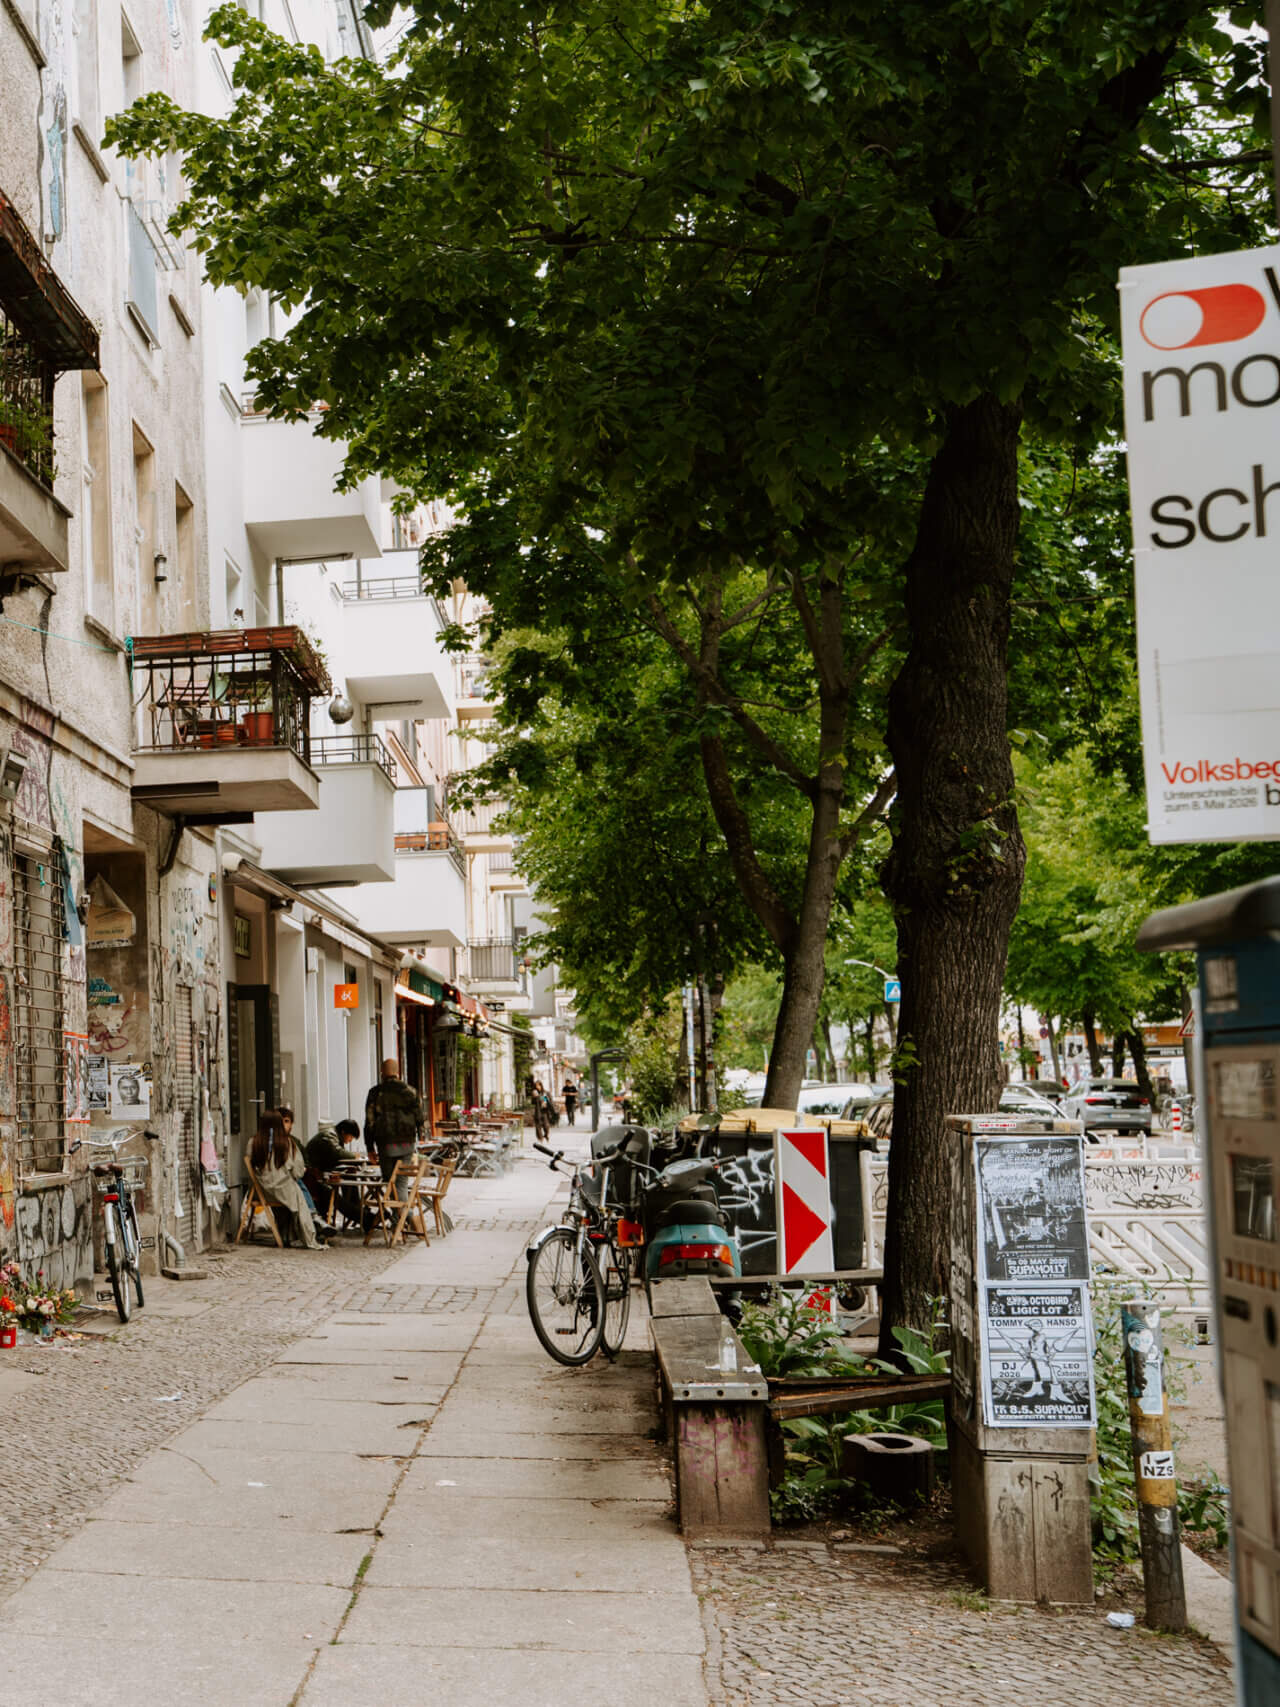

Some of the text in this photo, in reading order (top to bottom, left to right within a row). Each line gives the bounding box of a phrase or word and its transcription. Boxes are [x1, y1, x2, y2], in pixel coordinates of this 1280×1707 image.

[1150, 463, 1280, 550] sch
[1008, 1264, 1066, 1275] SUPAMOLLY
[990, 1319, 1024, 1327] TOMMY
[1001, 1362, 1017, 1370] DJ
[1034, 1404, 1089, 1415] SUPAMOLLY
